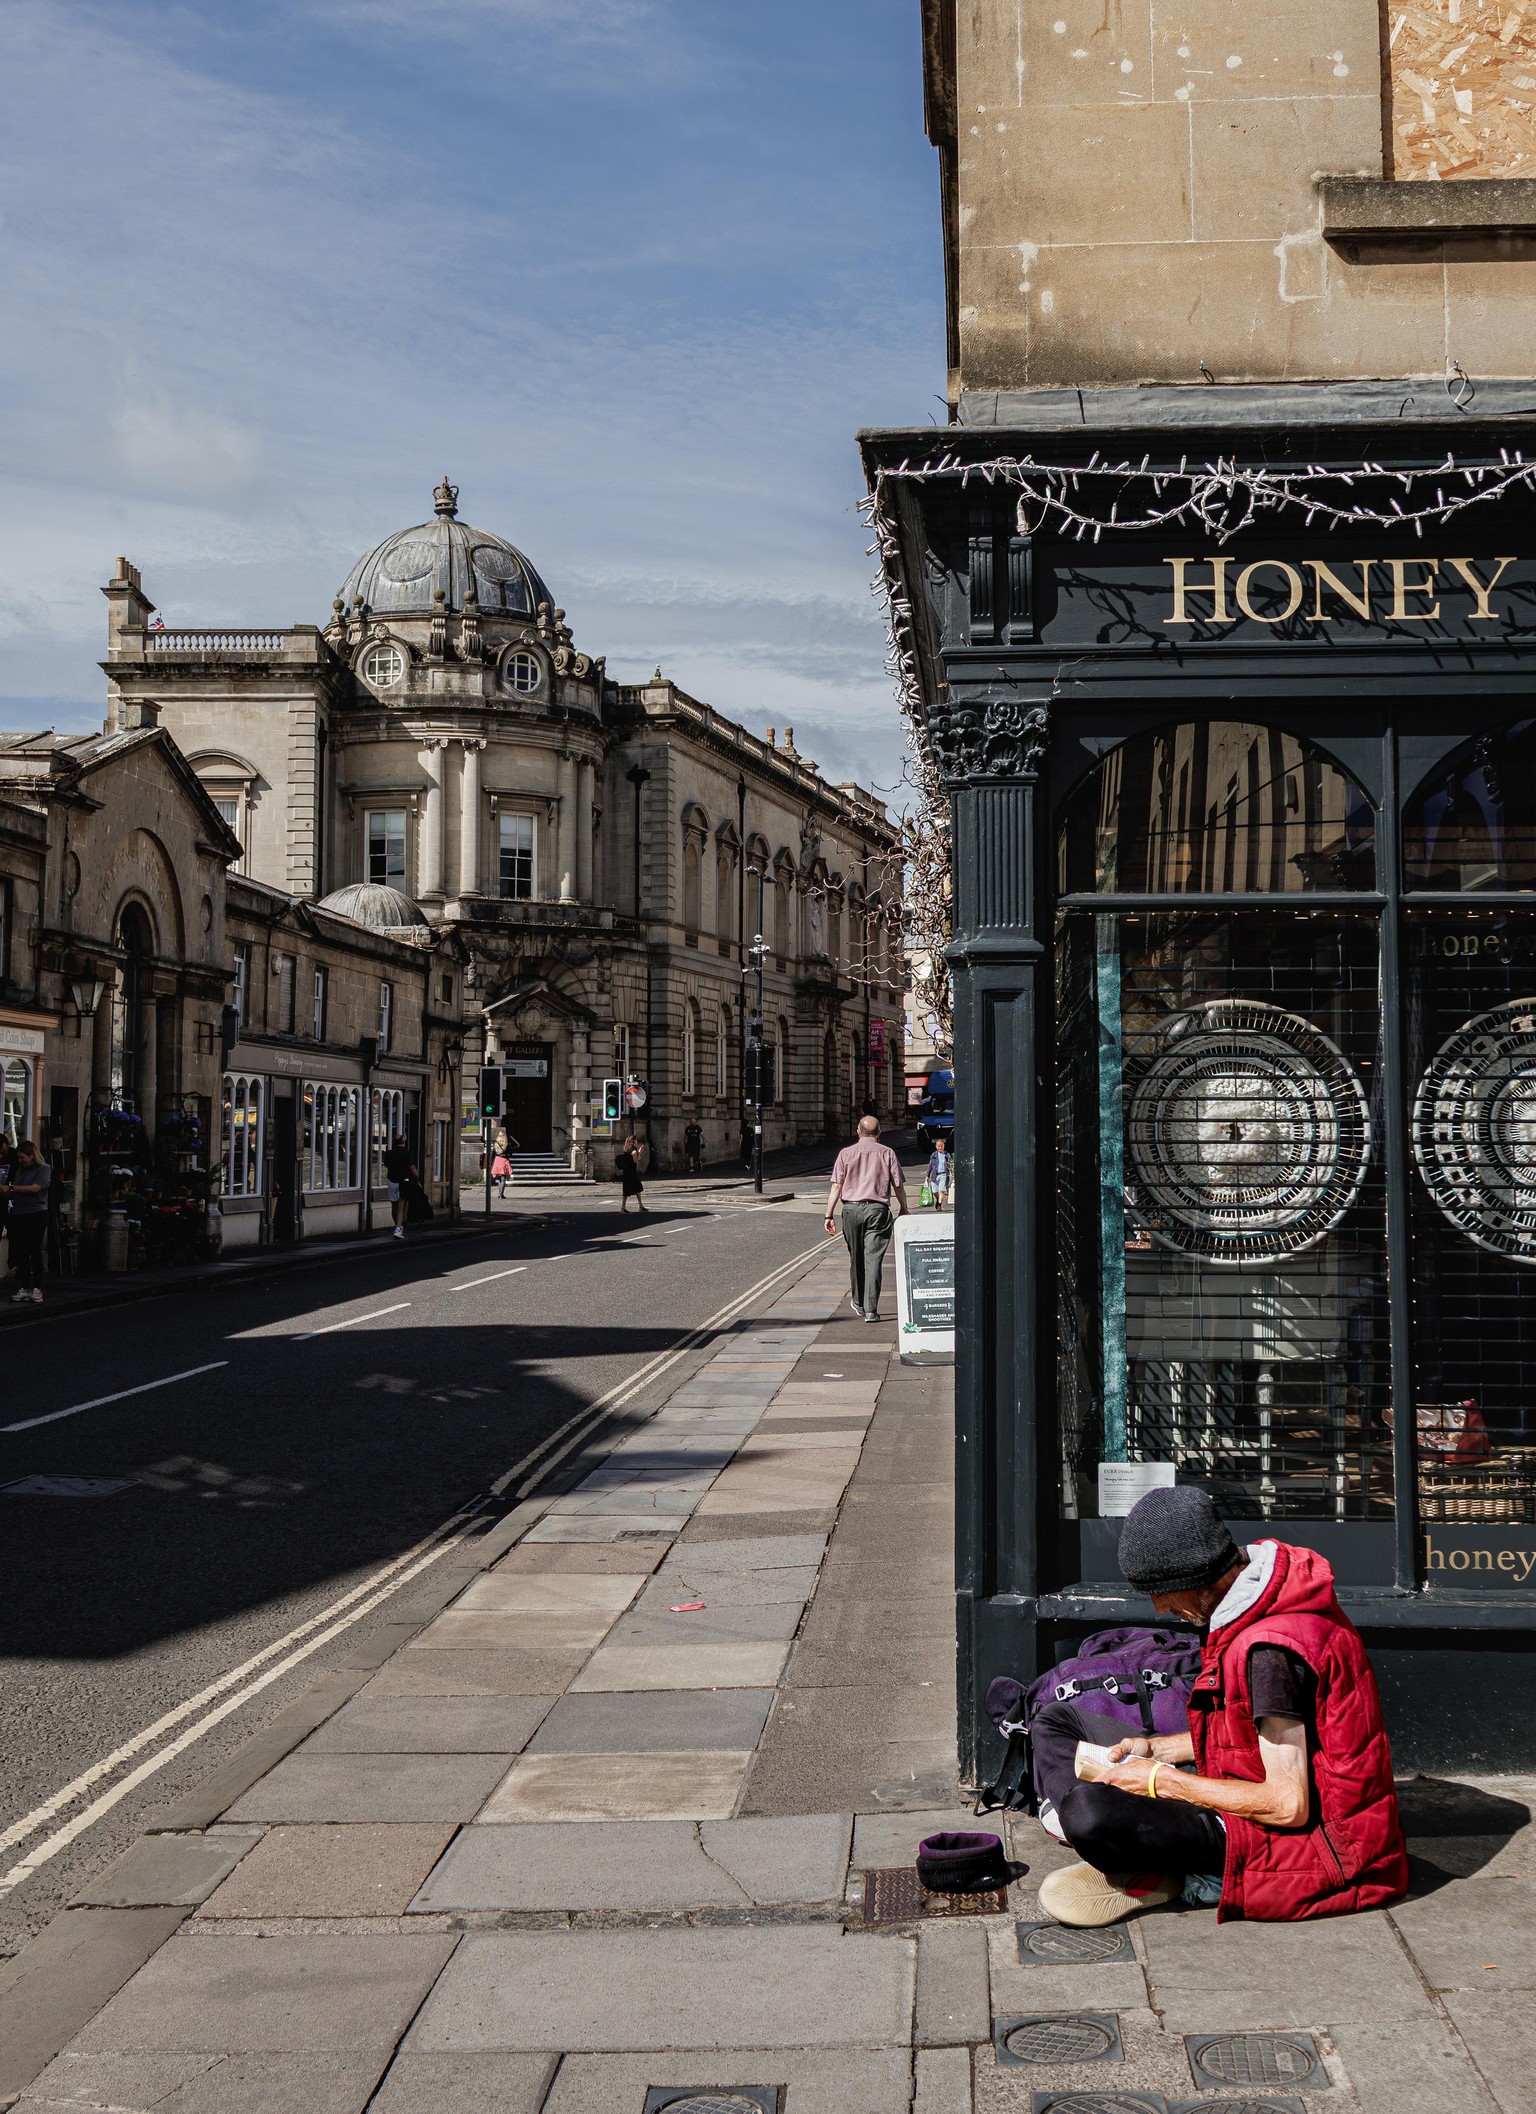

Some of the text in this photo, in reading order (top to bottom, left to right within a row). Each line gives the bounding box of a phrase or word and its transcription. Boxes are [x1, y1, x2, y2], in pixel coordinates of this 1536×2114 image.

[1162, 556, 1518, 624] HONEY
[5, 1030, 19, 1044] Coin
[20, 1032, 35, 1049] Shop
[1423, 1534, 1536, 1582] honey
